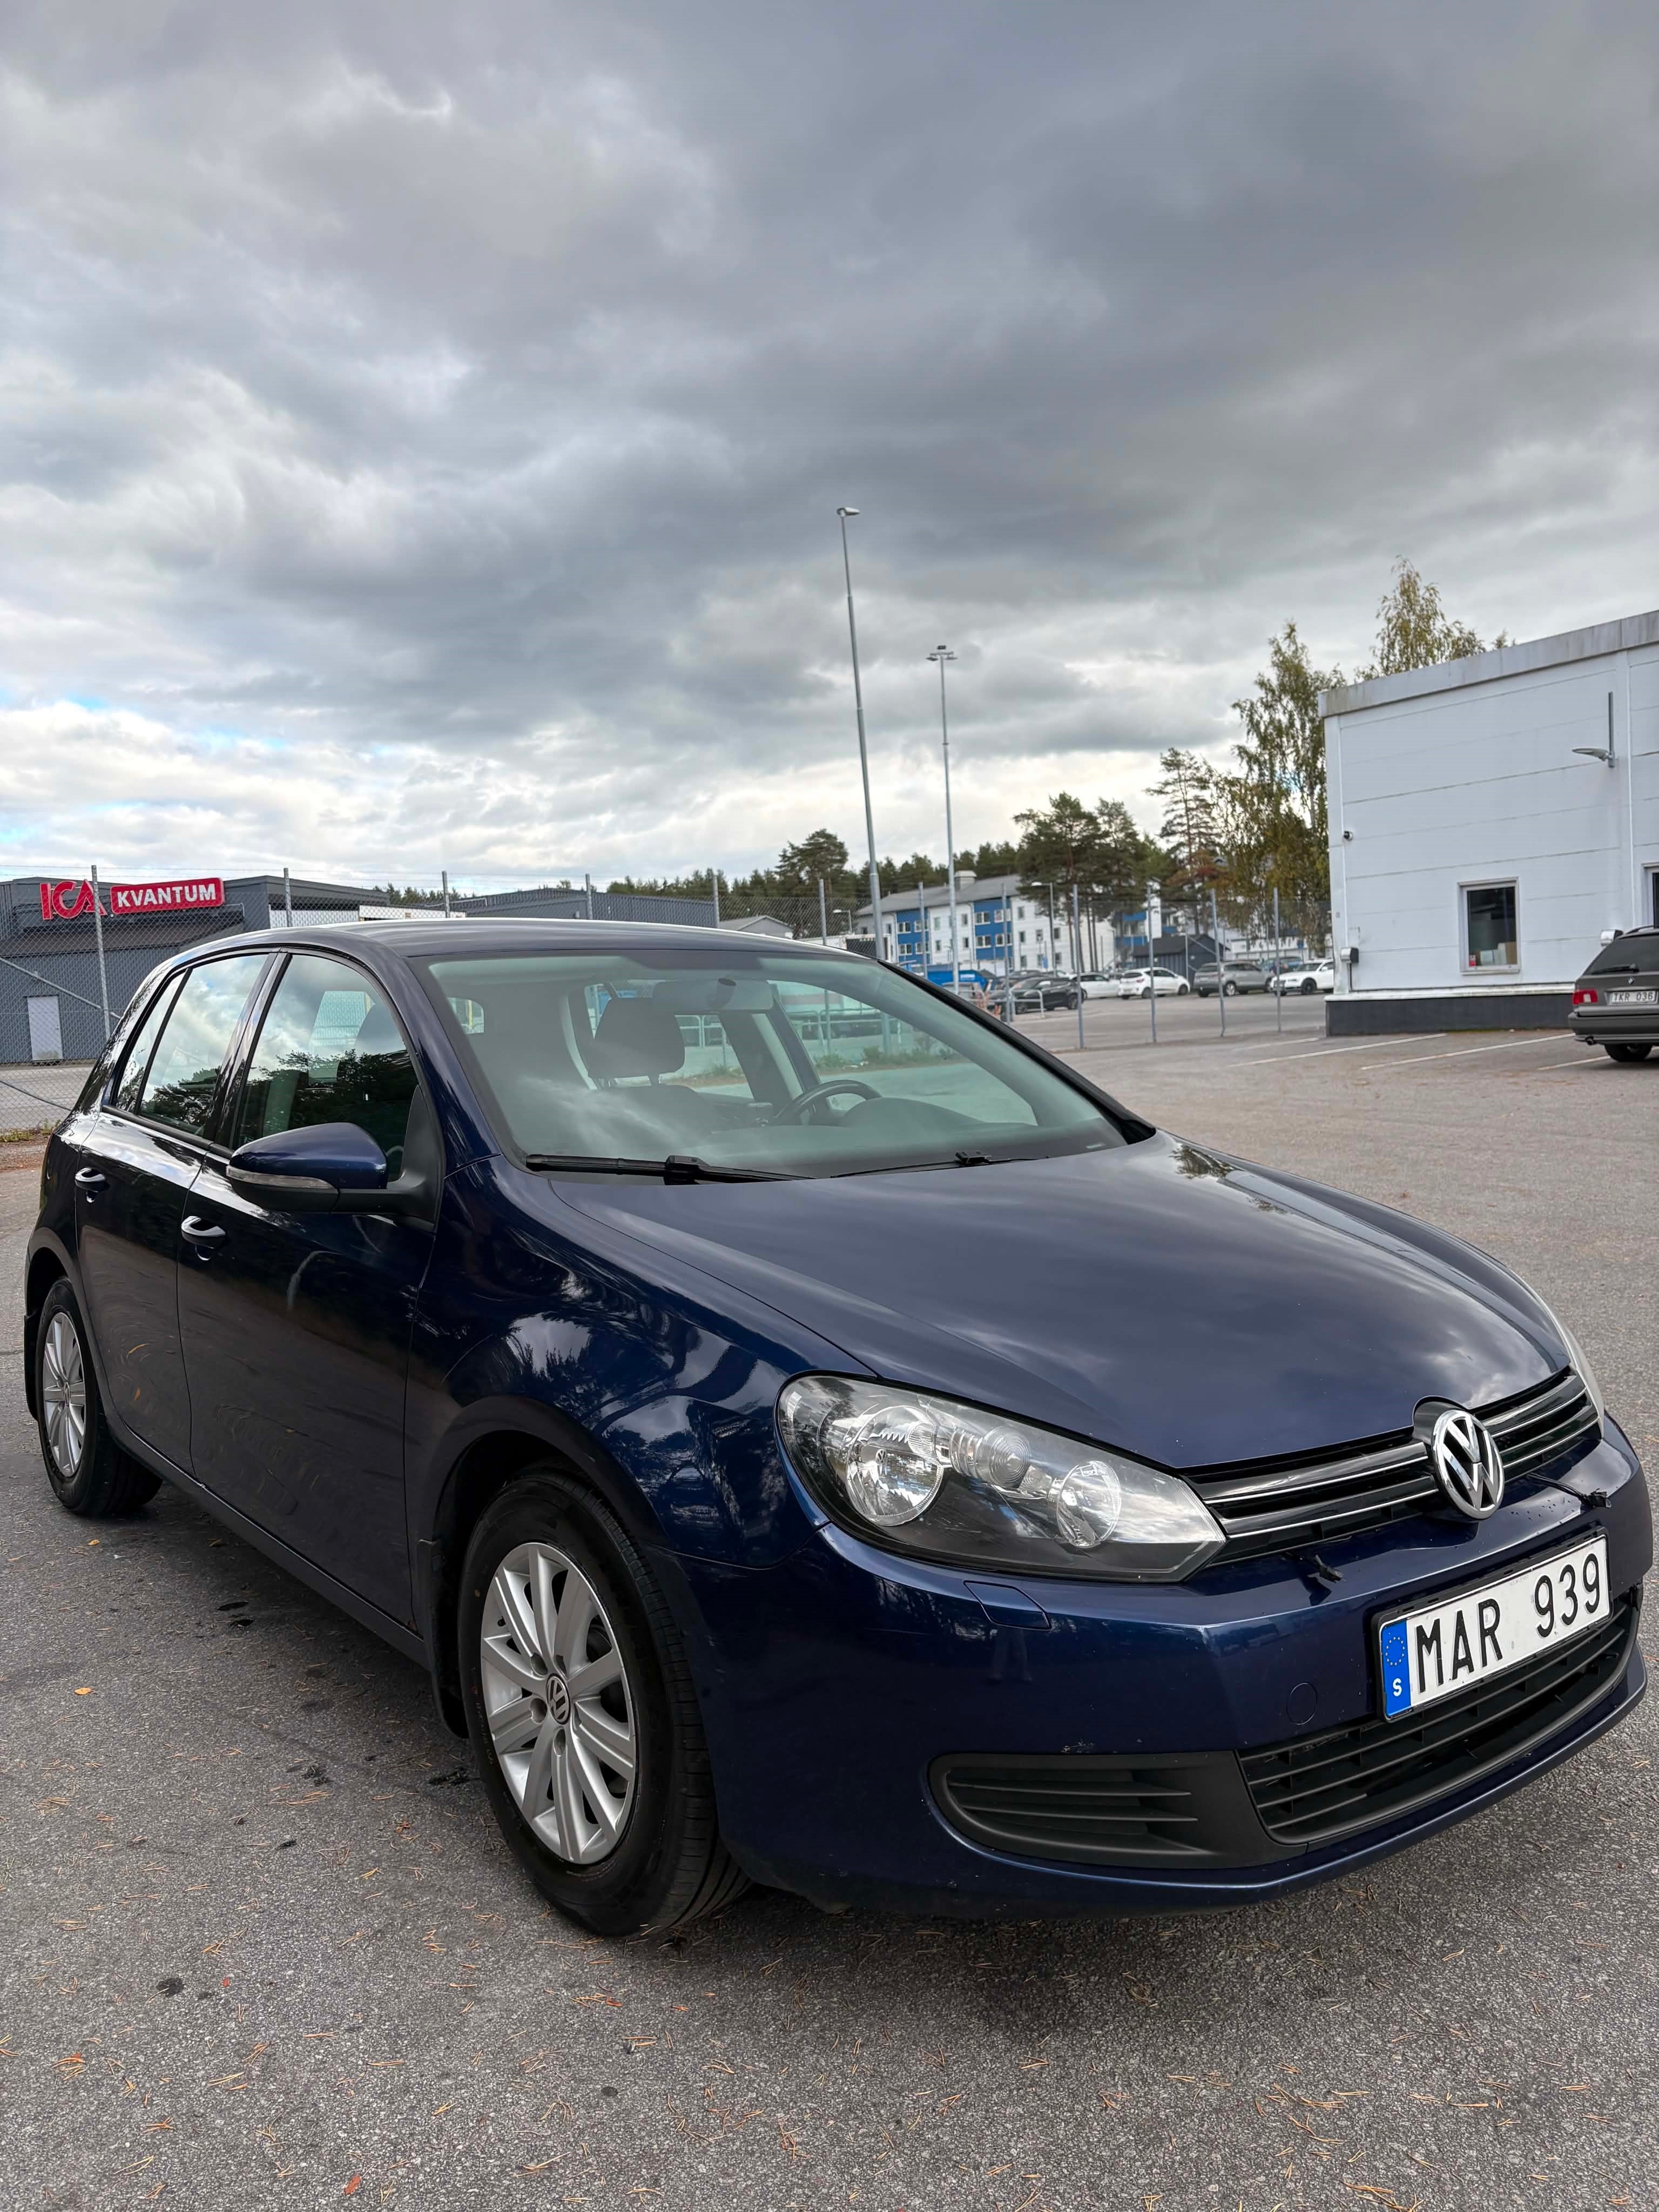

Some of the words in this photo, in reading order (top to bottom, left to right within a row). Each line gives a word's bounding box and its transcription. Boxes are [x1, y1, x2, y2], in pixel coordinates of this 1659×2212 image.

[40, 879, 107, 920] ICA
[117, 884, 216, 908] KVANTUM
[1615, 992, 1630, 1002] TKR
[1433, 1410, 1505, 1519] VW
[1415, 1598, 1503, 1693] MAR
[1534, 1553, 1600, 1637] 939
[547, 1675, 570, 1723] VW
[1392, 1677, 1402, 1697] S
